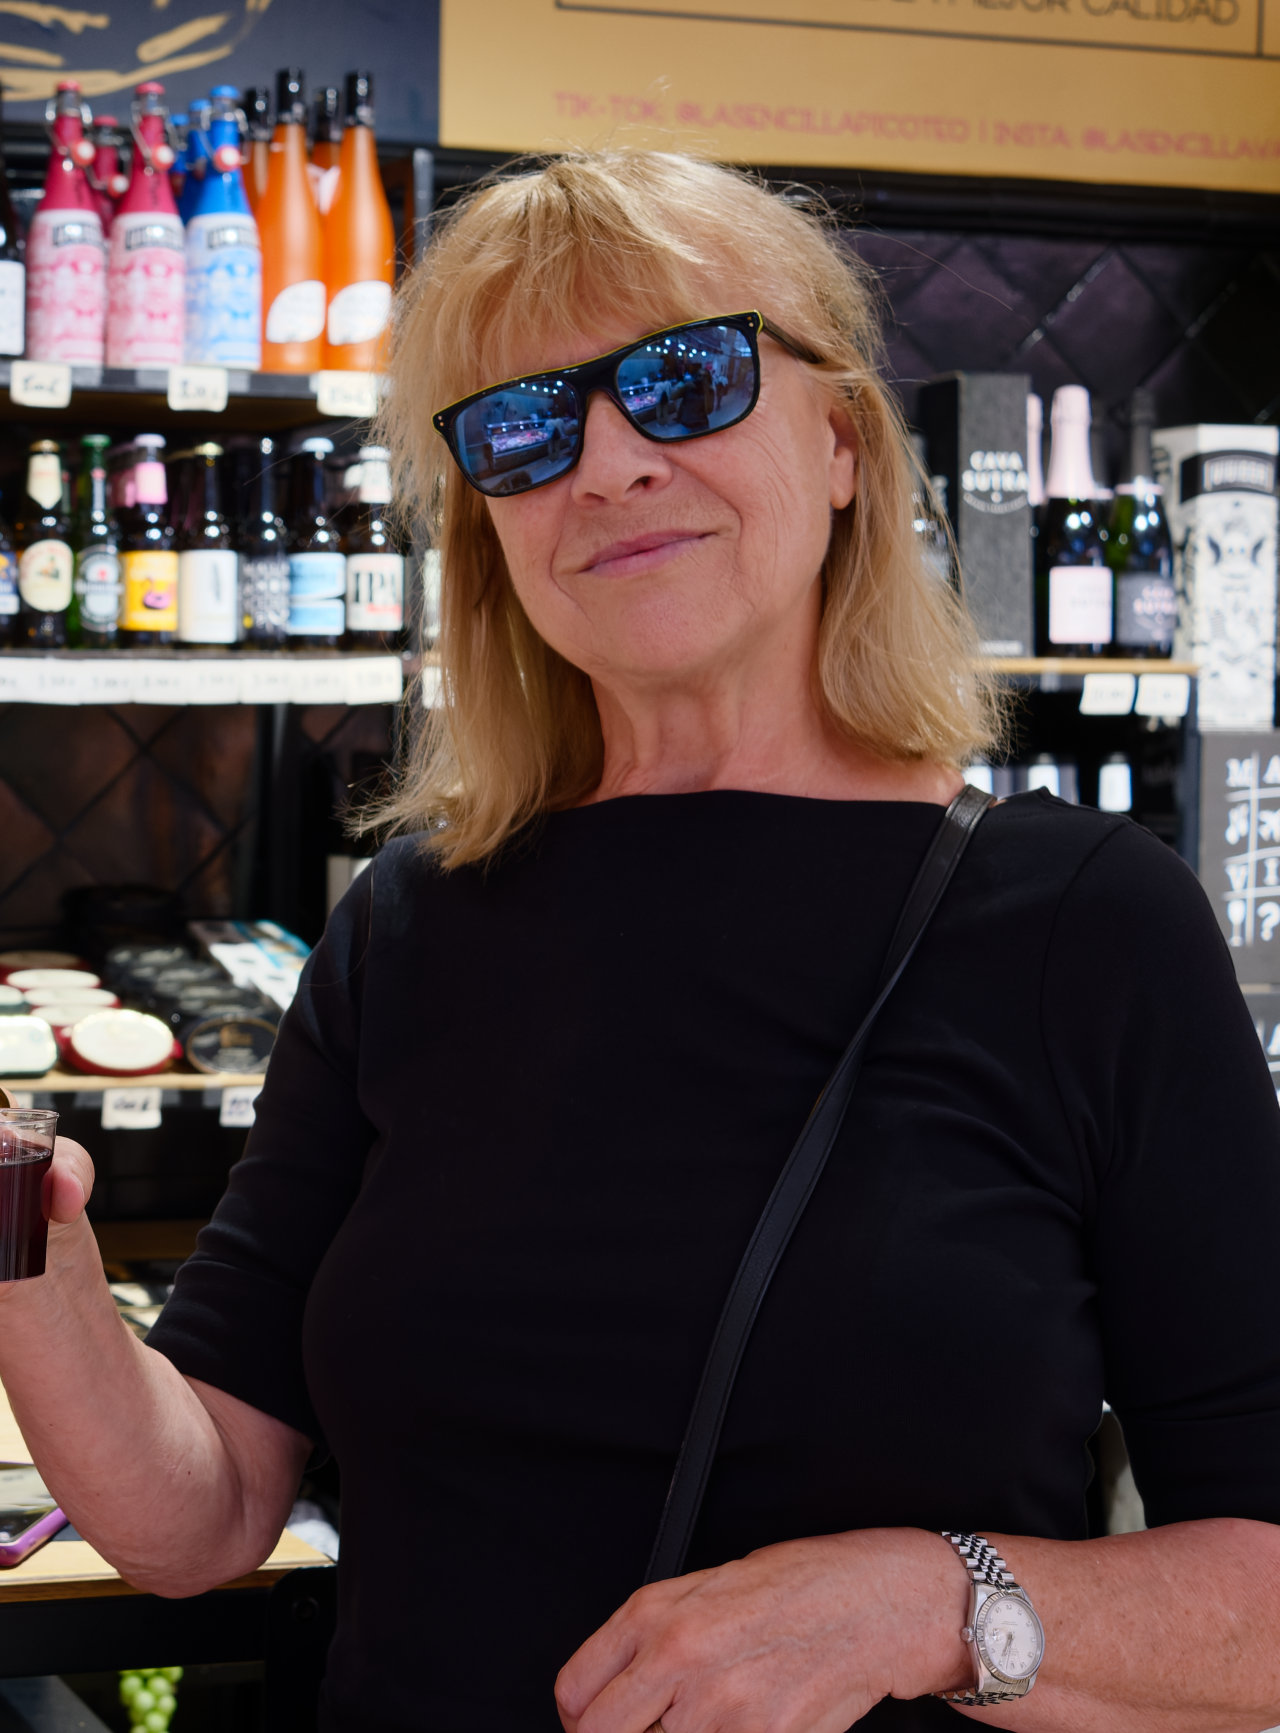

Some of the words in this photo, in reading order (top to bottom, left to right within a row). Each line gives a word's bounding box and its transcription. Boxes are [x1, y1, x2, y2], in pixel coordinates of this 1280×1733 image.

[554, 91, 666, 124] TIK-TOK
[992, 119, 1069, 148] INSTA
[969, 450, 1024, 471] CAVA
[961, 469, 1030, 492] SUTRA
